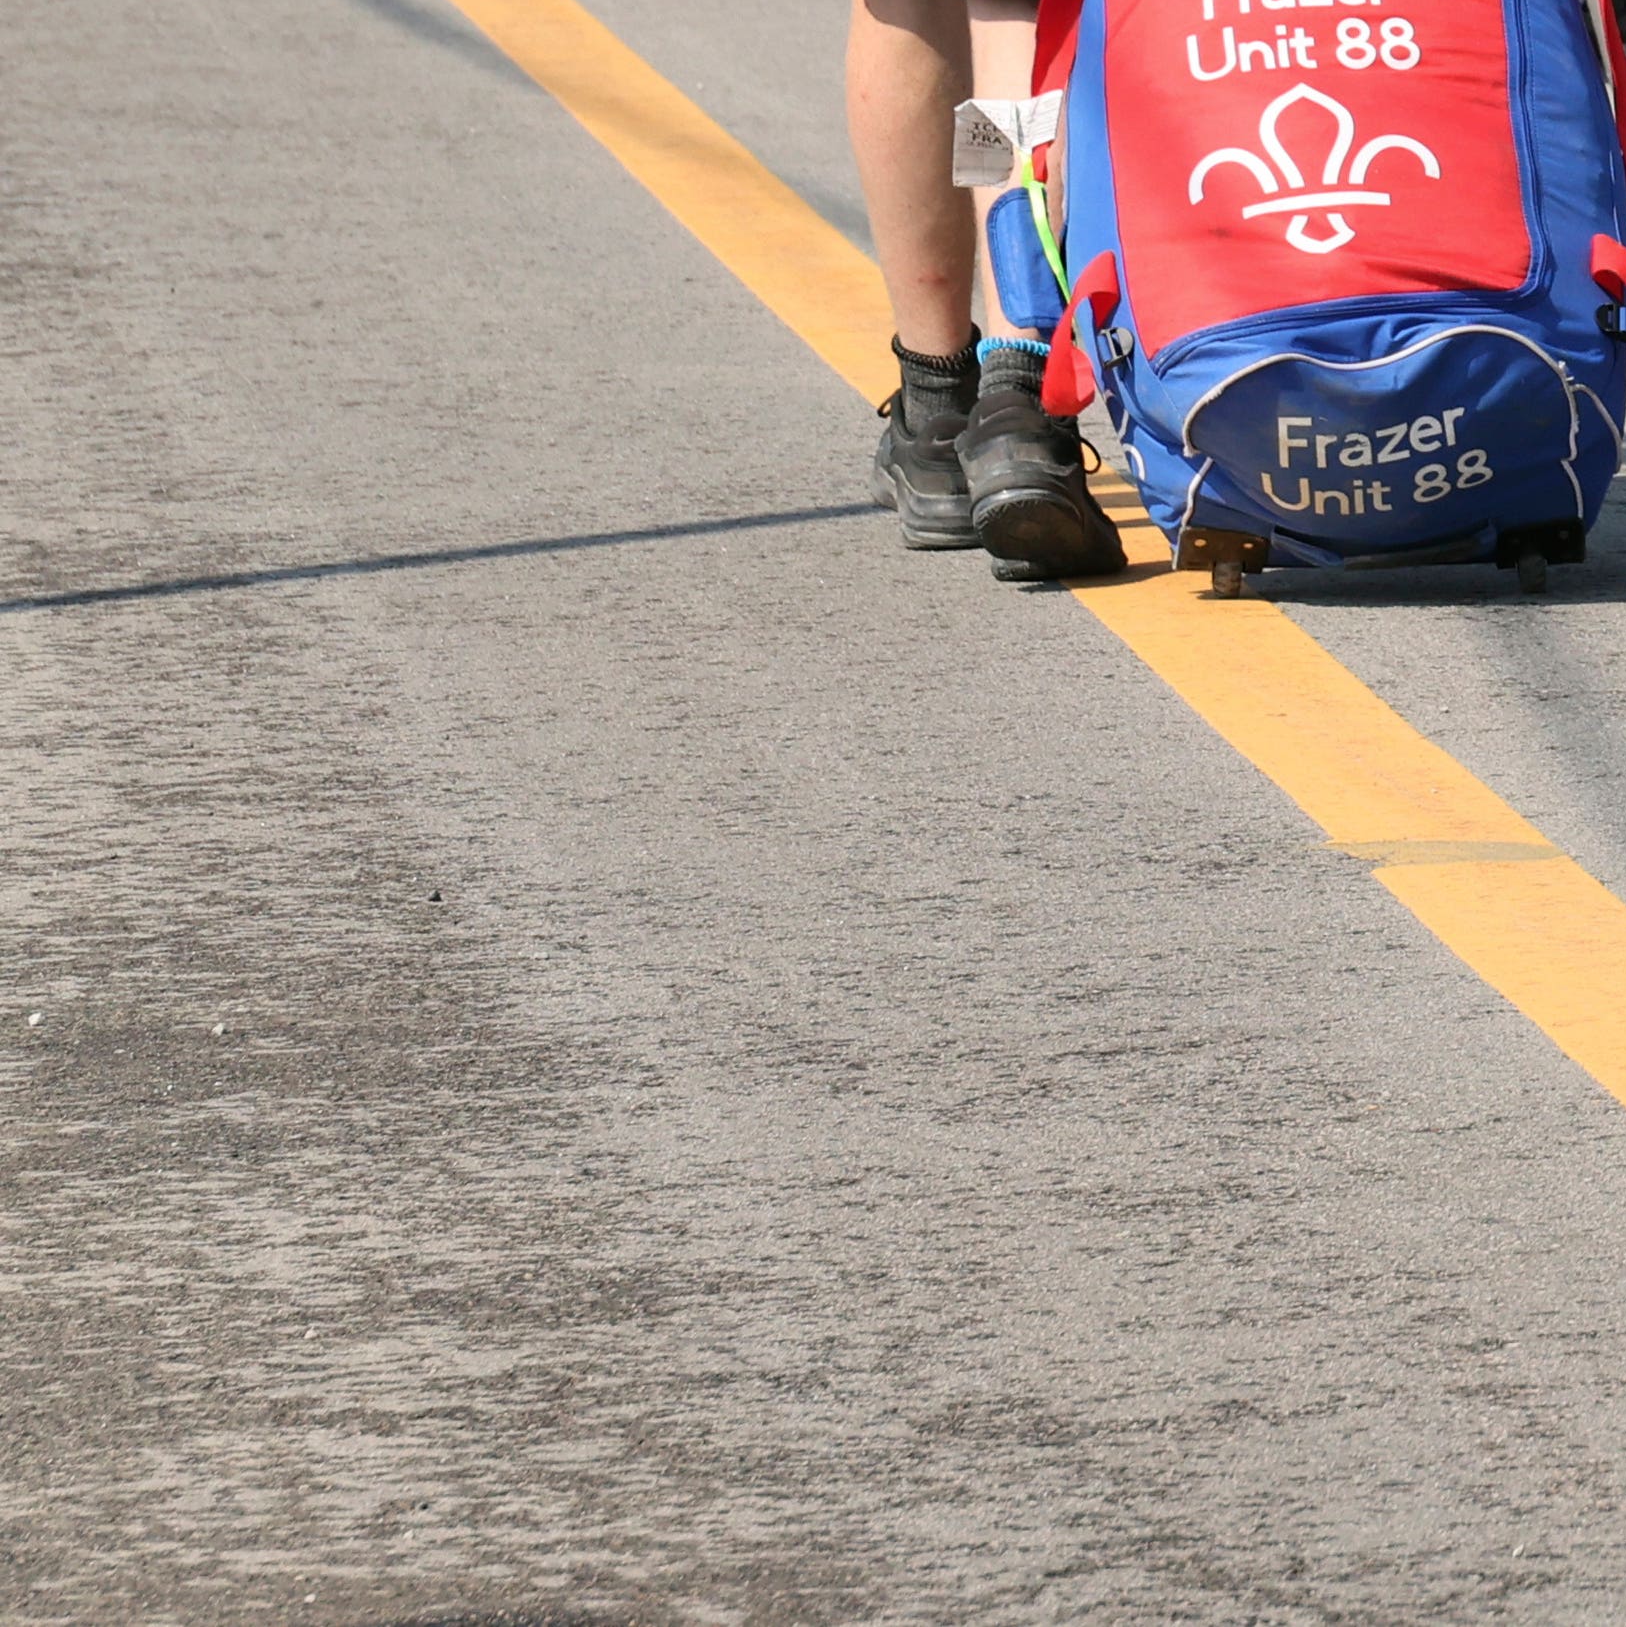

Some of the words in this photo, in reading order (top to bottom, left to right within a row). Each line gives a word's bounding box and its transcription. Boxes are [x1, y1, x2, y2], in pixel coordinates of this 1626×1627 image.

[1186, 24, 1318, 82] Unit
[1335, 17, 1421, 71] 88
[1277, 406, 1466, 470] Frazer
[1260, 471, 1393, 517] Unit
[1412, 448, 1494, 504] 88
